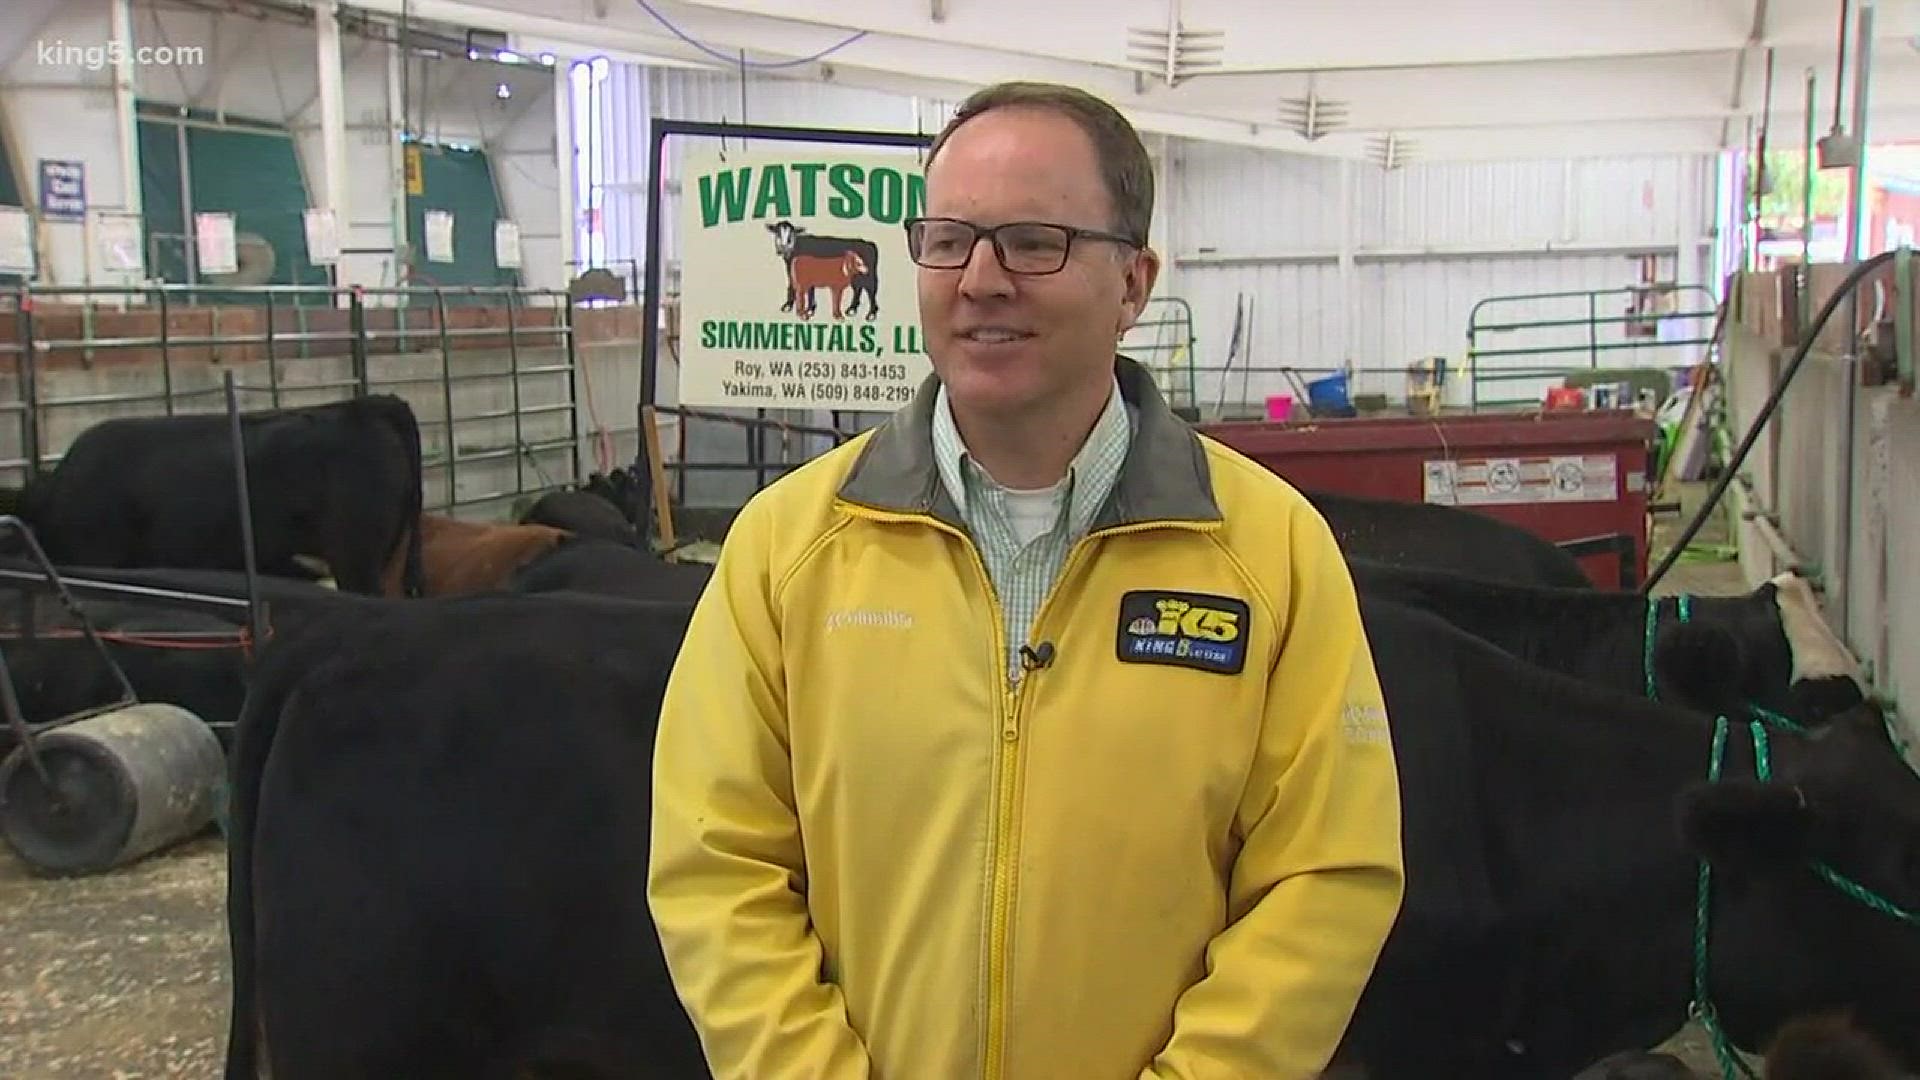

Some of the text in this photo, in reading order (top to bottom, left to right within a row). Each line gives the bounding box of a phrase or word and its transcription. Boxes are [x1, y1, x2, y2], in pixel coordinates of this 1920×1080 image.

[702, 320, 928, 357] SIMMENTALS, LL
[734, 360, 906, 381] Roy, WA (253) 843-1453
[722, 380, 915, 402] Yakima, WA (509) 848-2191
